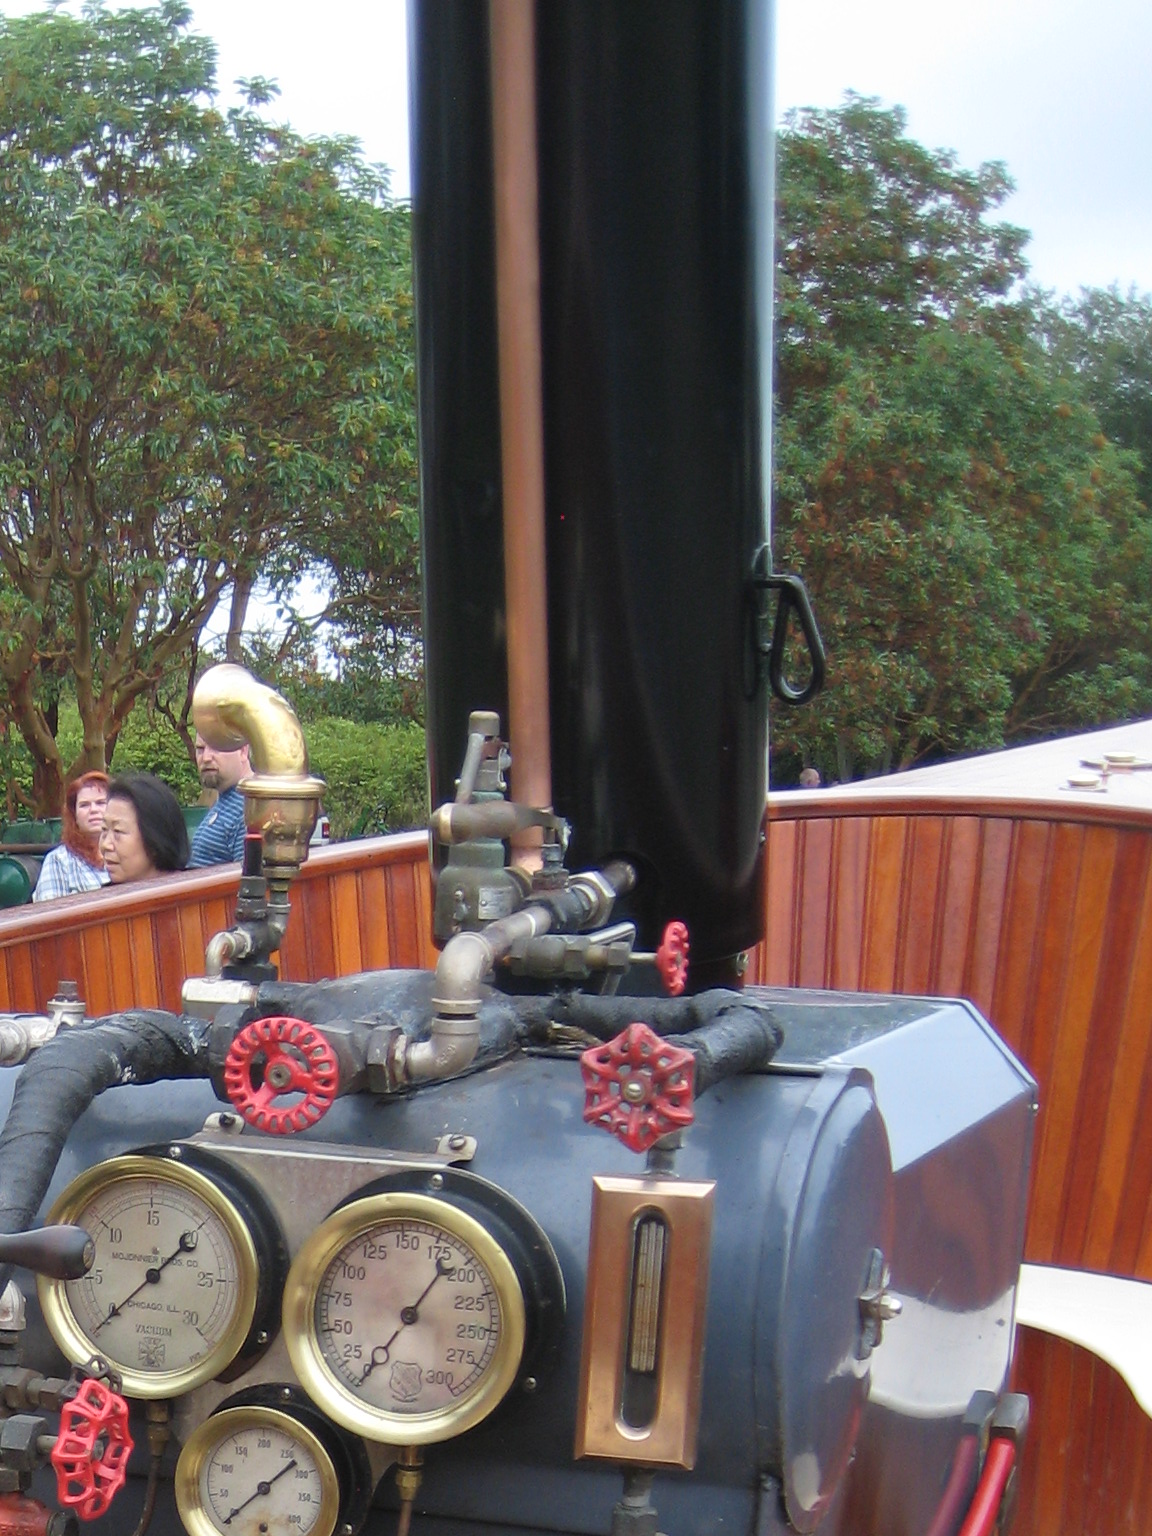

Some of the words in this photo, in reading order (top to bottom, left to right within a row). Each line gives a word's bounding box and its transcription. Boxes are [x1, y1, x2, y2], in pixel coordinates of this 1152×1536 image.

[147, 1211, 160, 1225] 15
[109, 1228, 122, 1242] 10
[396, 1235, 419, 1251] 150
[112, 1252, 160, 1264] MOJONNIER
[364, 1244, 387, 1260] 125
[428, 1246, 451, 1262] 175
[95, 1270, 102, 1284] 5
[343, 1265, 365, 1280] 100
[448, 1269, 475, 1283] 200
[198, 1272, 213, 1288] 25
[335, 1292, 352, 1306] 75
[455, 1296, 485, 1311] 225
[183, 1310, 198, 1326] 30
[136, 1324, 172, 1336] VACUUM
[334, 1320, 353, 1335] 50
[457, 1325, 485, 1340] 250
[344, 1344, 362, 1359] 25
[447, 1349, 474, 1364] 275
[426, 1370, 453, 1385] 300
[257, 1439, 271, 1448] 200
[235, 1447, 248, 1456] 150
[281, 1450, 294, 1458] 250
[221, 1464, 233, 1473] 100
[295, 1470, 308, 1479] 300
[220, 1489, 228, 1497] 50
[298, 1493, 311, 1502] 350
